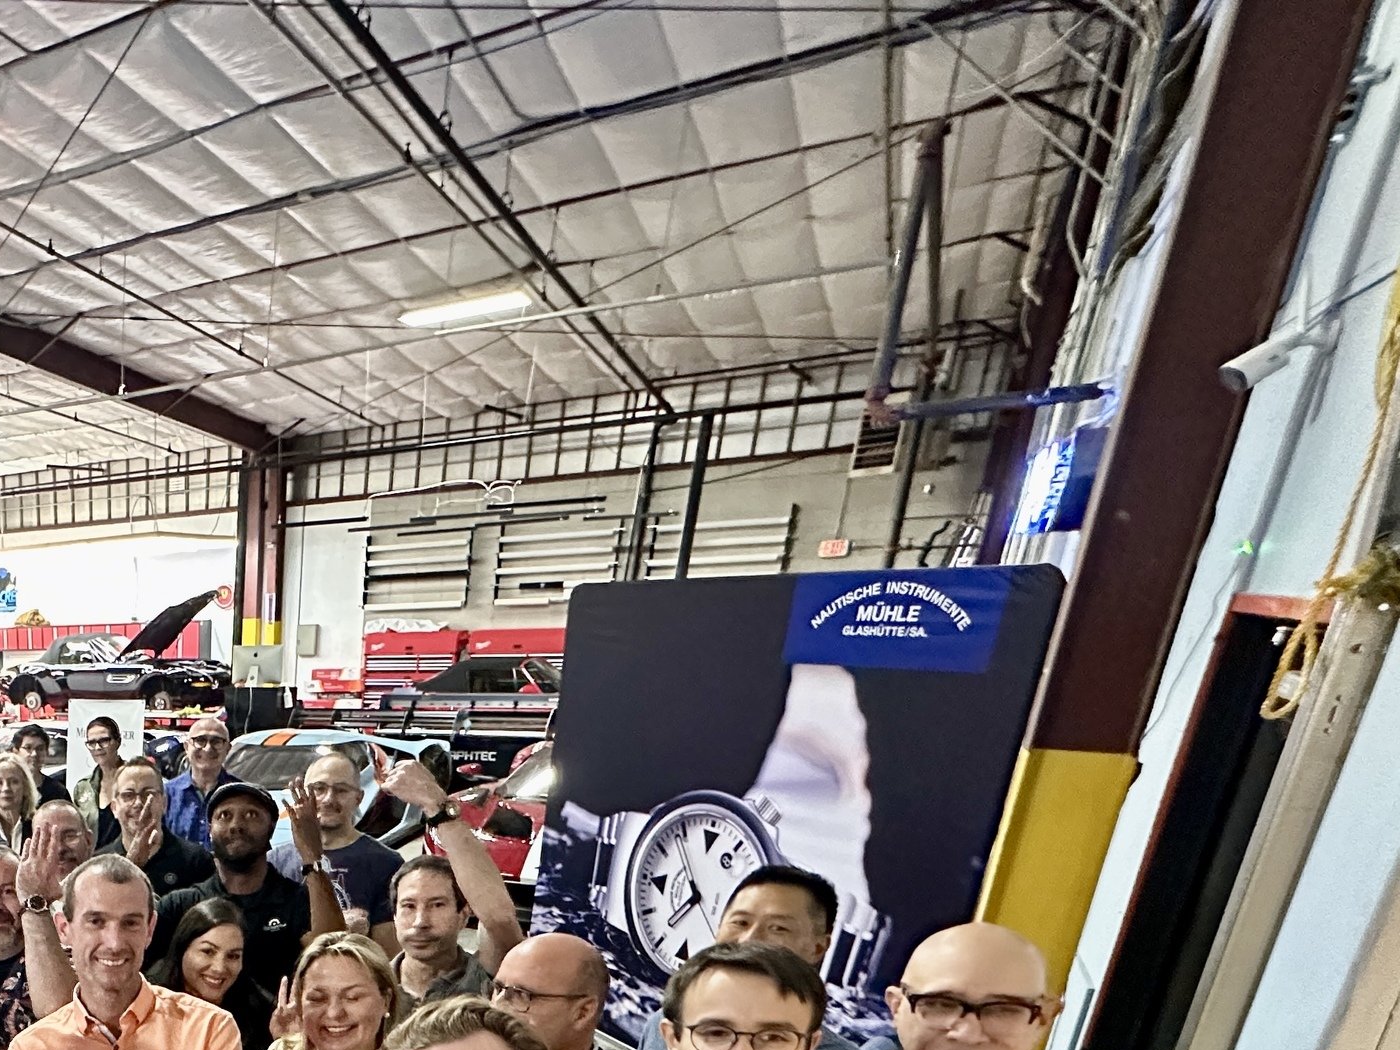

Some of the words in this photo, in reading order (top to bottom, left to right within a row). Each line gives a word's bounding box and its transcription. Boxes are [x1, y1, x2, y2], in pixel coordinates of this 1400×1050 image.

[810, 582, 881, 629] NAUTISCHE
[885, 581, 972, 632] INSTRUMENTE
[855, 601, 921, 622] MÜHLE
